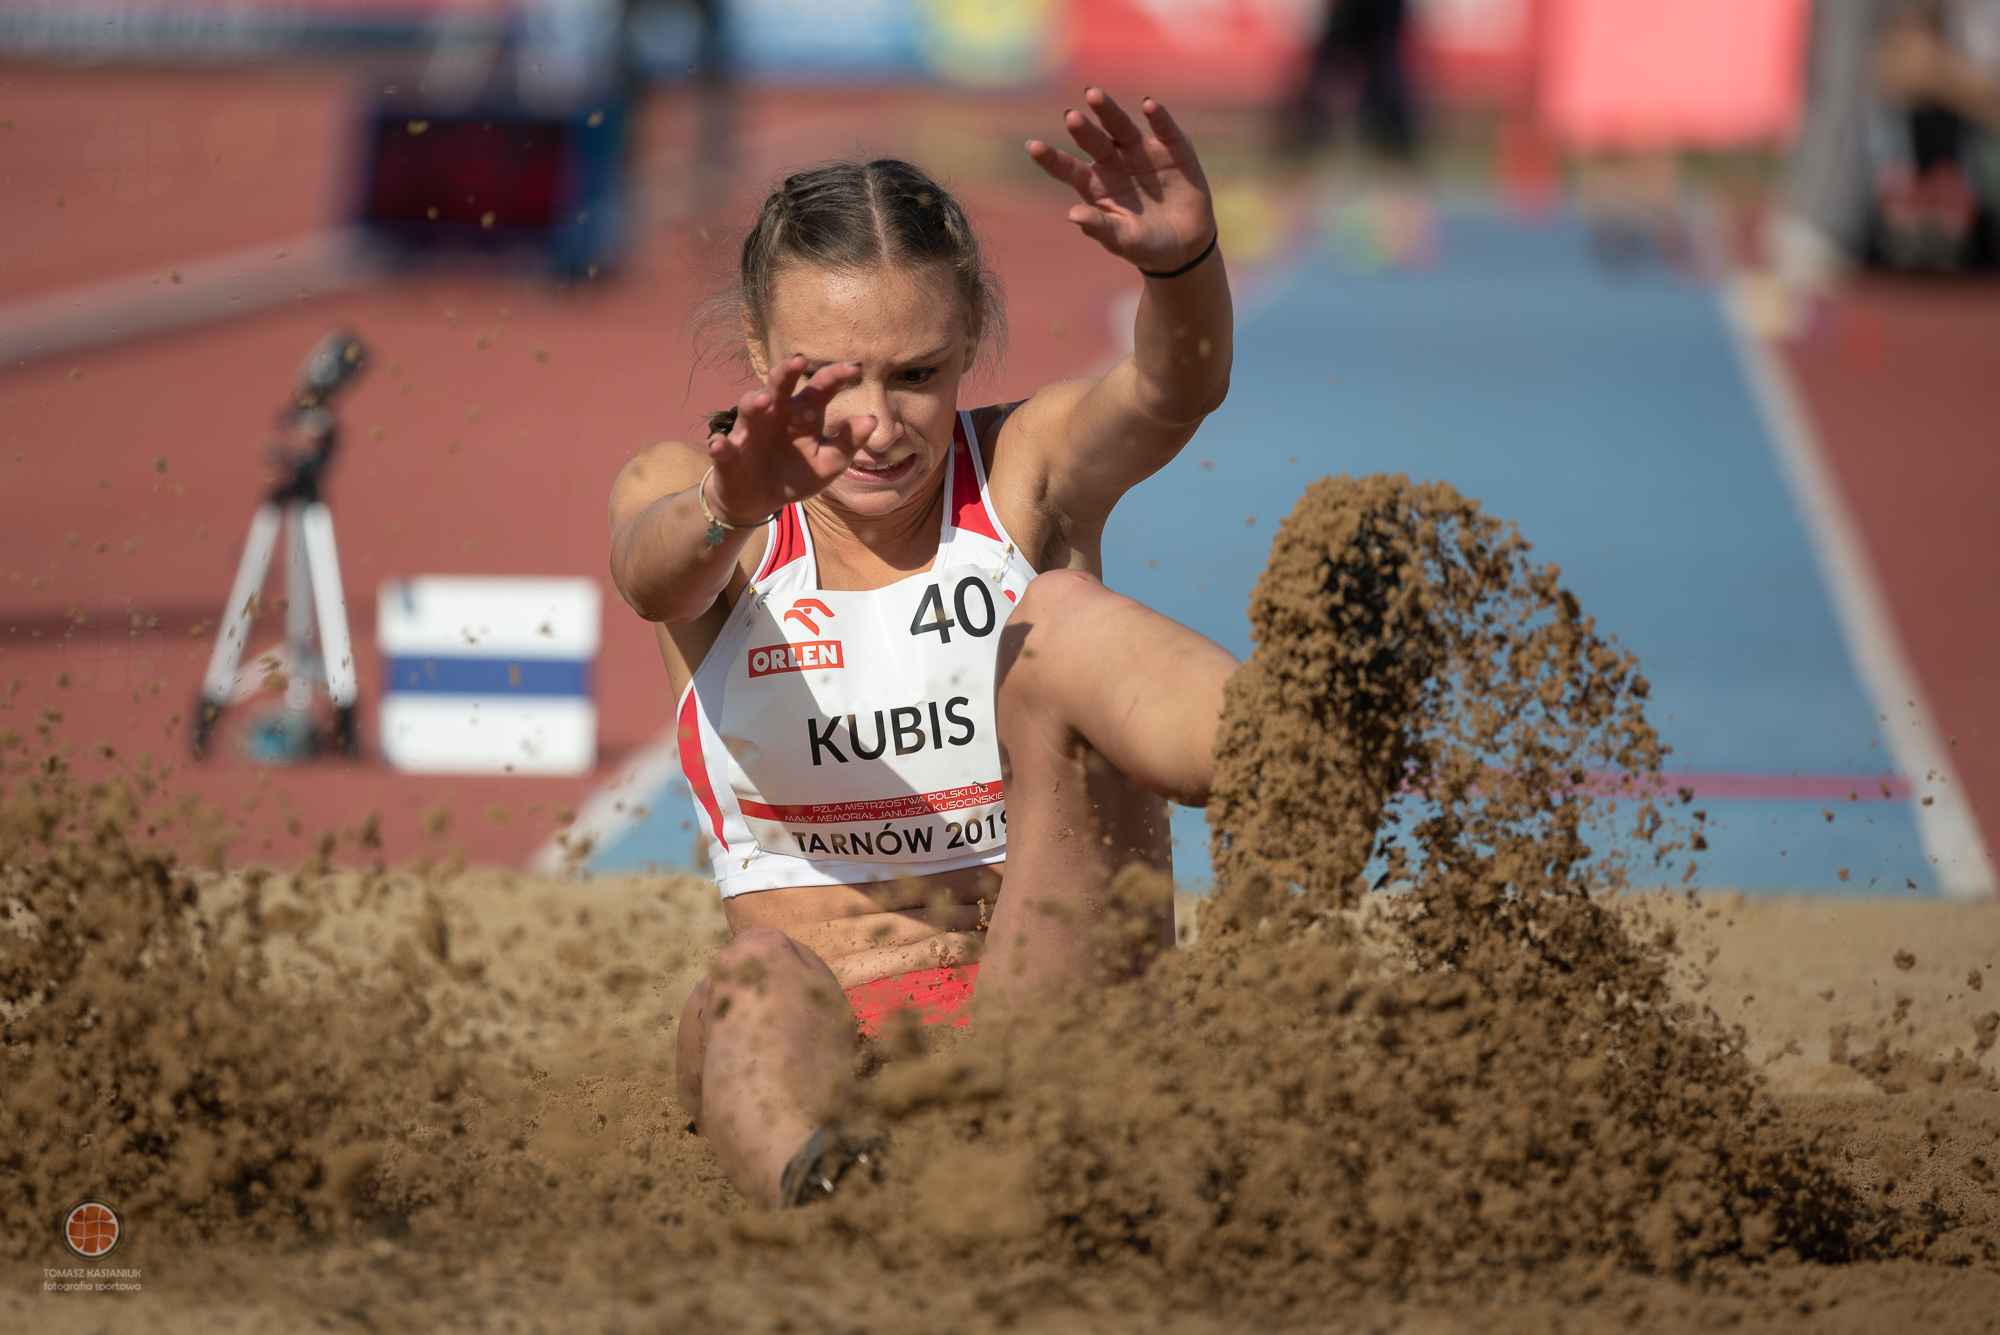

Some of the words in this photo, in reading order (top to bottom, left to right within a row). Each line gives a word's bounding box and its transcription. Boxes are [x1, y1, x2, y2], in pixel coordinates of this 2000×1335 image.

[910, 576, 995, 644] 40
[752, 644, 838, 672] ORLEN
[807, 696, 975, 766] KUBIS
[784, 815, 814, 823] MAŁY
[816, 812, 876, 823] MEMORIAŁ
[877, 805, 932, 819] JANUSZA
[812, 804, 843, 813] PZLA
[844, 795, 926, 811] MISTRZOSTWA
[927, 788, 968, 802] POLSKI
[791, 822, 933, 855] TARNÓW
